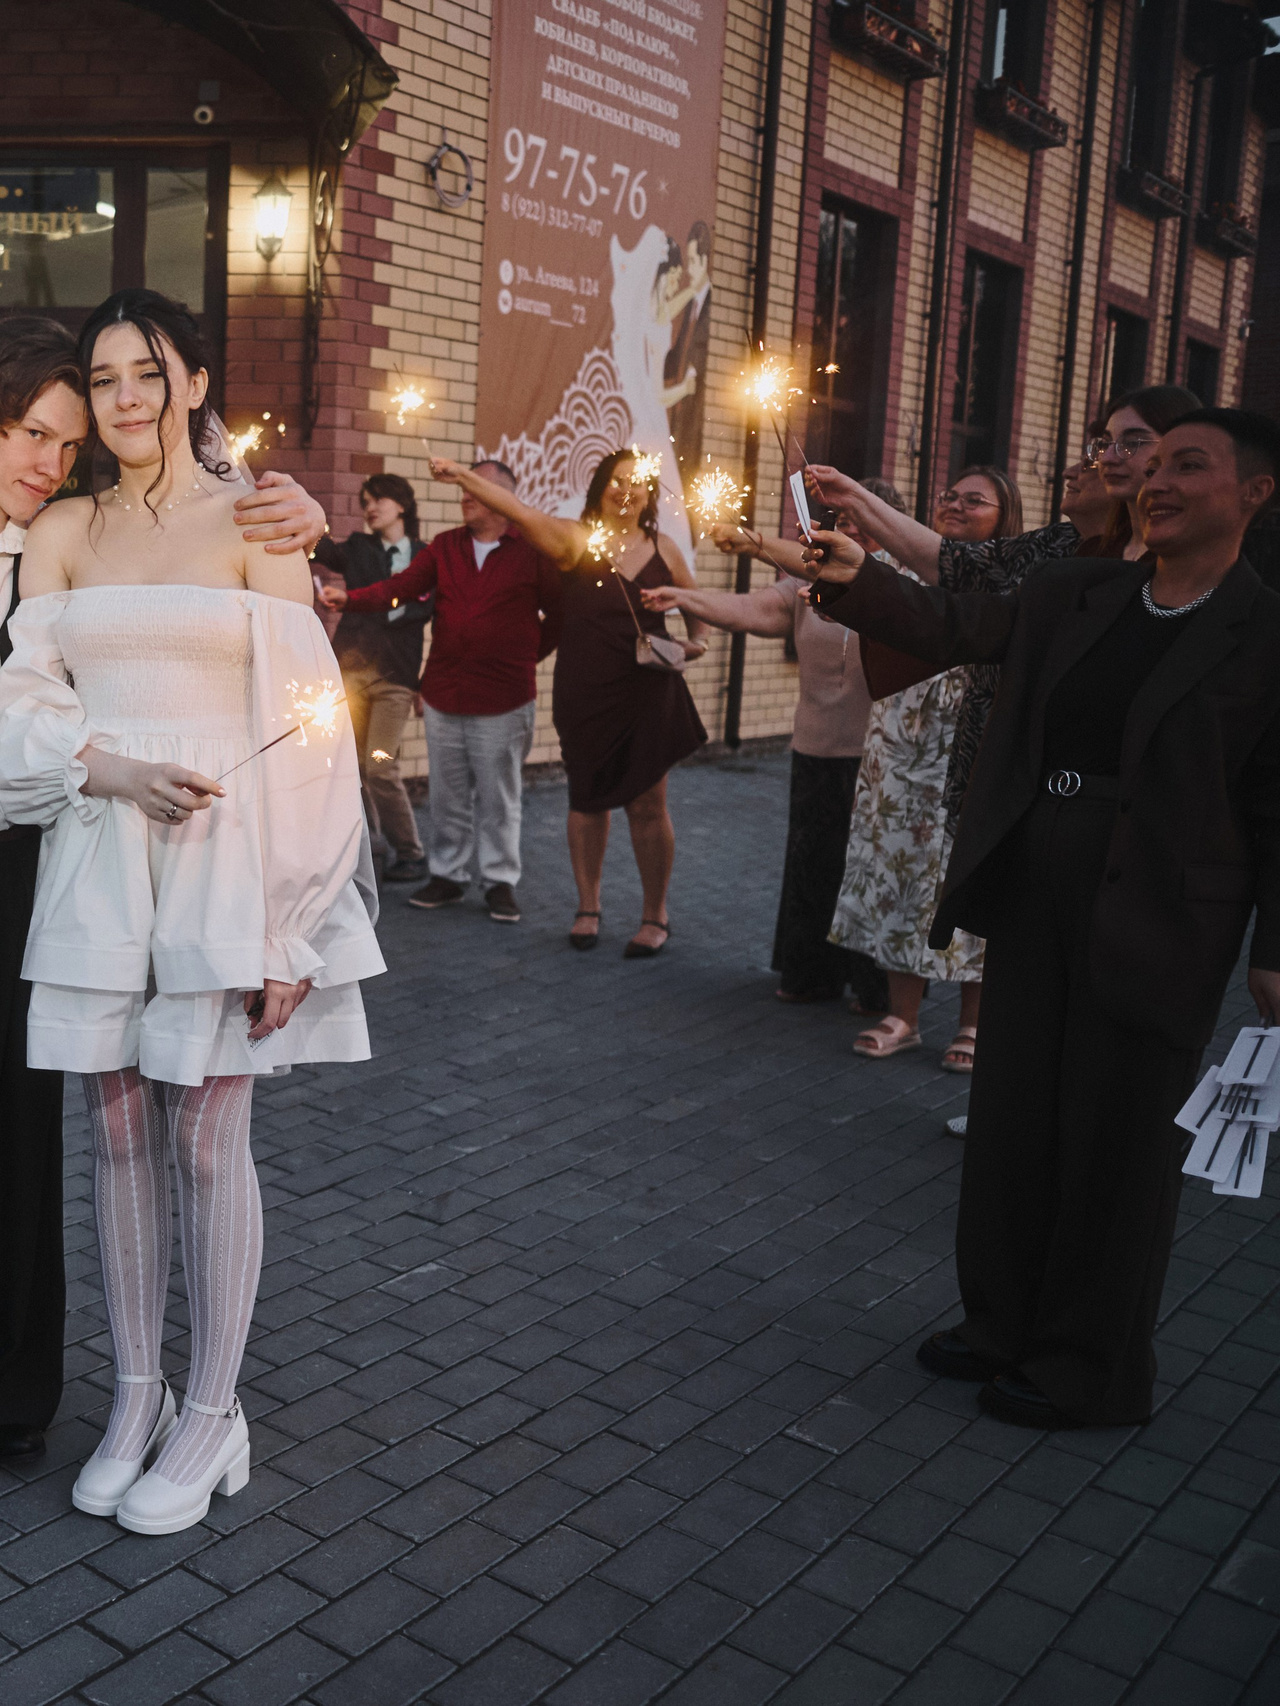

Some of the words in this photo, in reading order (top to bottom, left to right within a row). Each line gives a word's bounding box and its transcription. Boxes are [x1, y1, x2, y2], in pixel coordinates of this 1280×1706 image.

[534, 15, 599, 61] ЮБИЛЕЕВ,
[552, 0, 601, 28] СВАДЕБ
[546, 53, 604, 90] ДЕТСКИХ
[604, 75, 679, 120] ПРАЗДНИКОВ
[541, 81, 553, 100] И
[553, 85, 631, 131] ВЫПУСКНЫХ
[631, 115, 681, 149] ВЕЧЕРОВ
[503, 127, 649, 220] 97-75-76
[501, 191, 510, 213] 8
[511, 193, 546, 227] (922)
